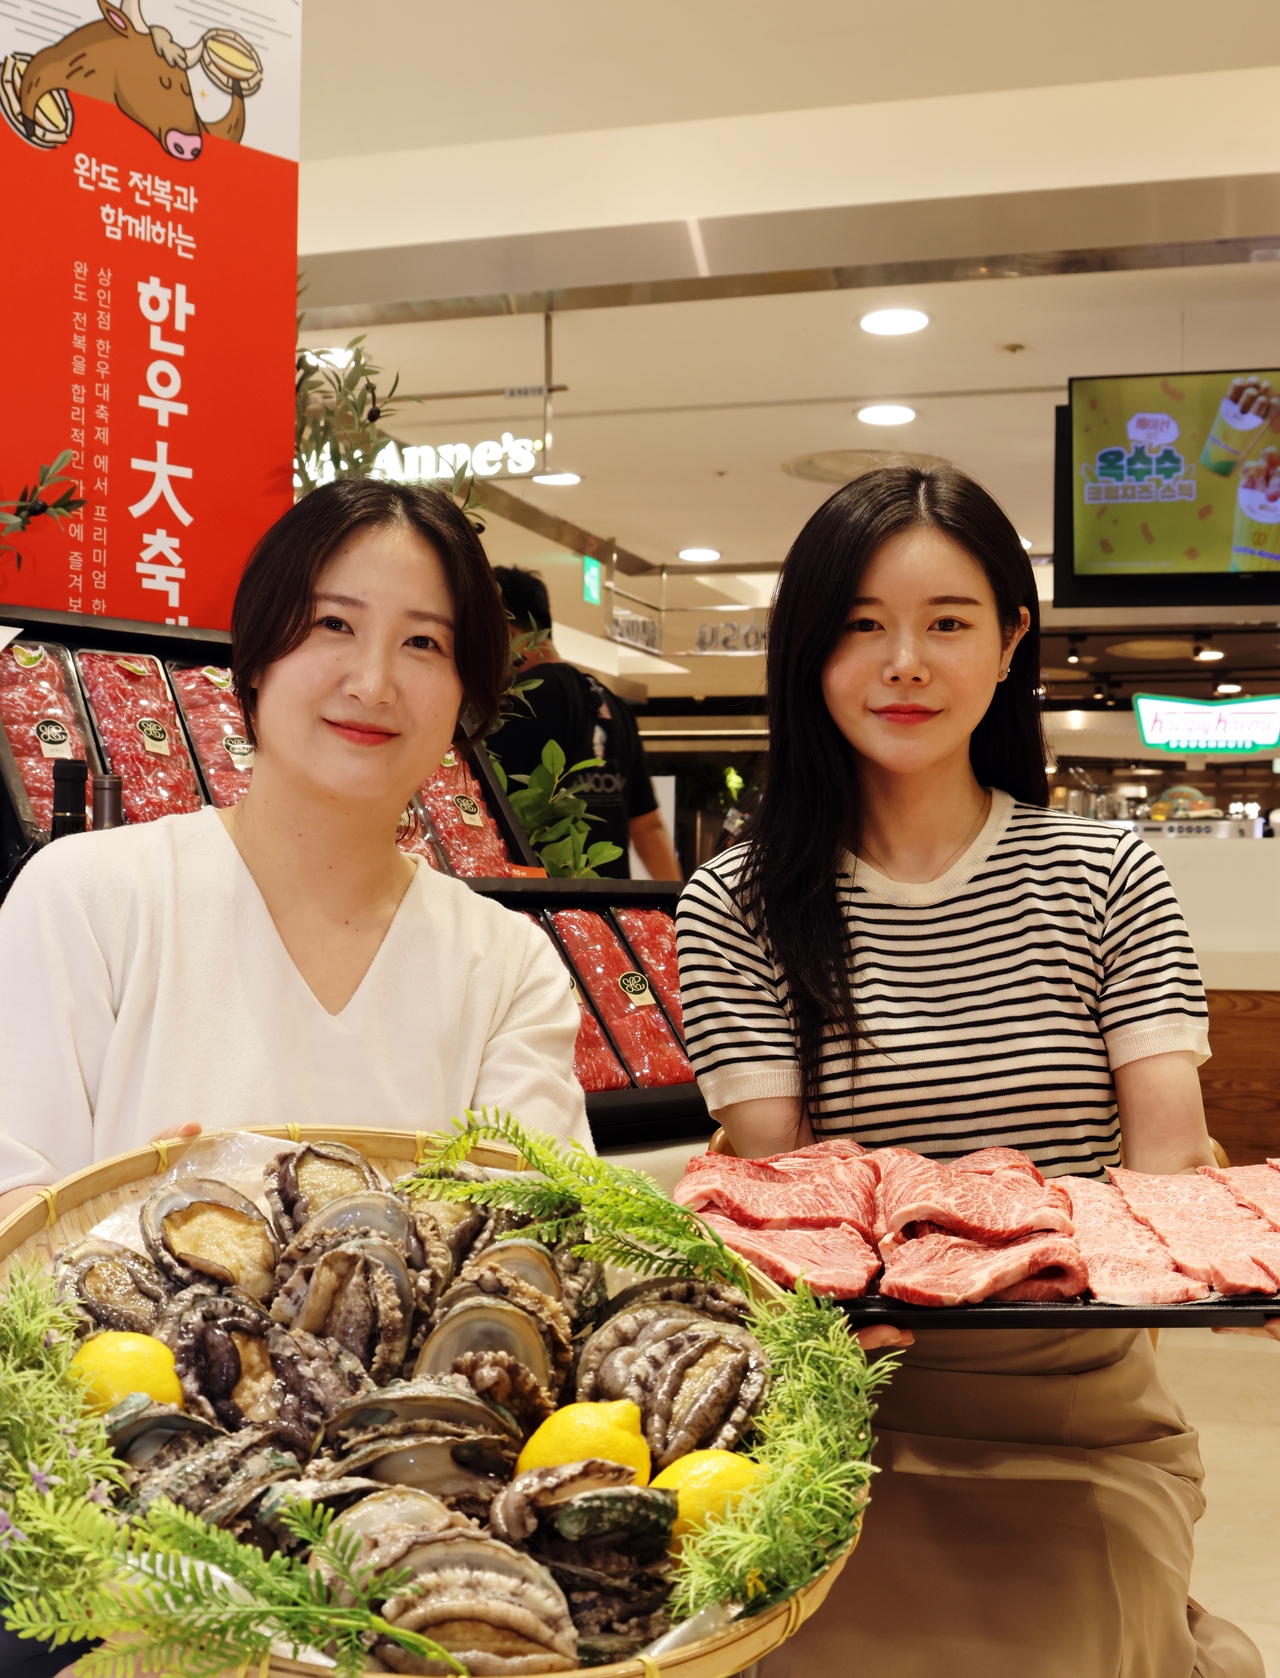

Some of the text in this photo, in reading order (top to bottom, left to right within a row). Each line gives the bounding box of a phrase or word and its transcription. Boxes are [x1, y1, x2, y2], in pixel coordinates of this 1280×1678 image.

[73, 152, 198, 213] 완도 전복과
[100, 203, 197, 259] 함께하는
[73, 260, 88, 302] 완도
[96, 267, 112, 331] 상인점
[71, 311, 87, 376] 전복을
[70, 383, 86, 470] 합리적인
[128, 275, 195, 626] 한우大축
[366, 432, 536, 480] Anne's
[1098, 445, 1182, 483] 옥수수
[92, 505, 108, 590] 프리미엄
